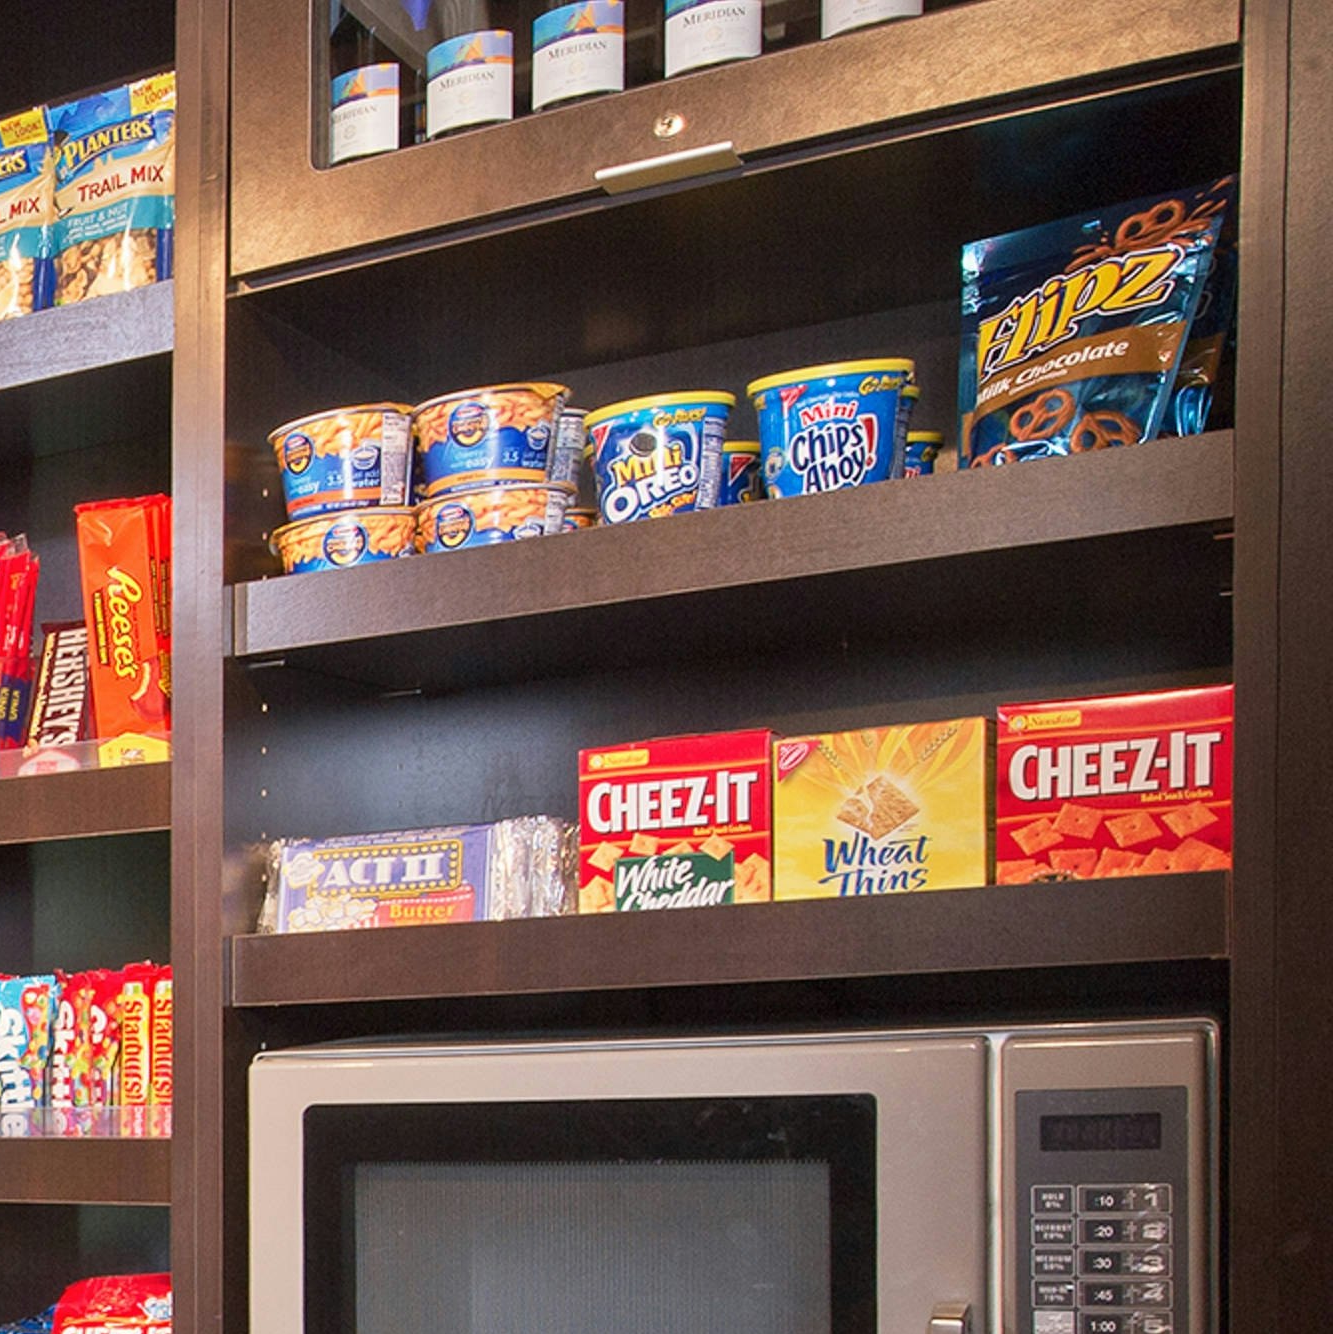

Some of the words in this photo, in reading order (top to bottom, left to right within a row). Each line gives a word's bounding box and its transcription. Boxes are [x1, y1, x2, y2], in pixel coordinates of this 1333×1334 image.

[682, 6, 747, 26] MERIDIAN
[547, 40, 607, 61] MERIDIAN
[439, 70, 496, 92] MERIDIAN
[63, 118, 153, 168] PLANTERS
[78, 177, 125, 202] TRAIL
[131, 166, 164, 184] MIX
[9, 197, 40, 220] MIX
[979, 250, 1179, 379] Flipz
[1016, 341, 1129, 384] Chocolate
[801, 402, 857, 426] Mini
[791, 423, 863, 471] Chips
[604, 466, 699, 523] OREO
[107, 566, 141, 678] Reese's
[1009, 731, 1222, 801] CHEEZ-IT
[587, 770, 758, 833] CHEEZ-IT
[323, 857, 396, 889] ACT
[402, 853, 444, 882] II
[823, 832, 933, 876] Wheat
[617, 856, 694, 897] White
[621, 878, 734, 910] Cheddar
[818, 867, 929, 897] Thins
[389, 904, 457, 918] Butter
[124, 1000, 145, 1103] Starburst
[1090, 1321, 1116, 1332] 1:00
